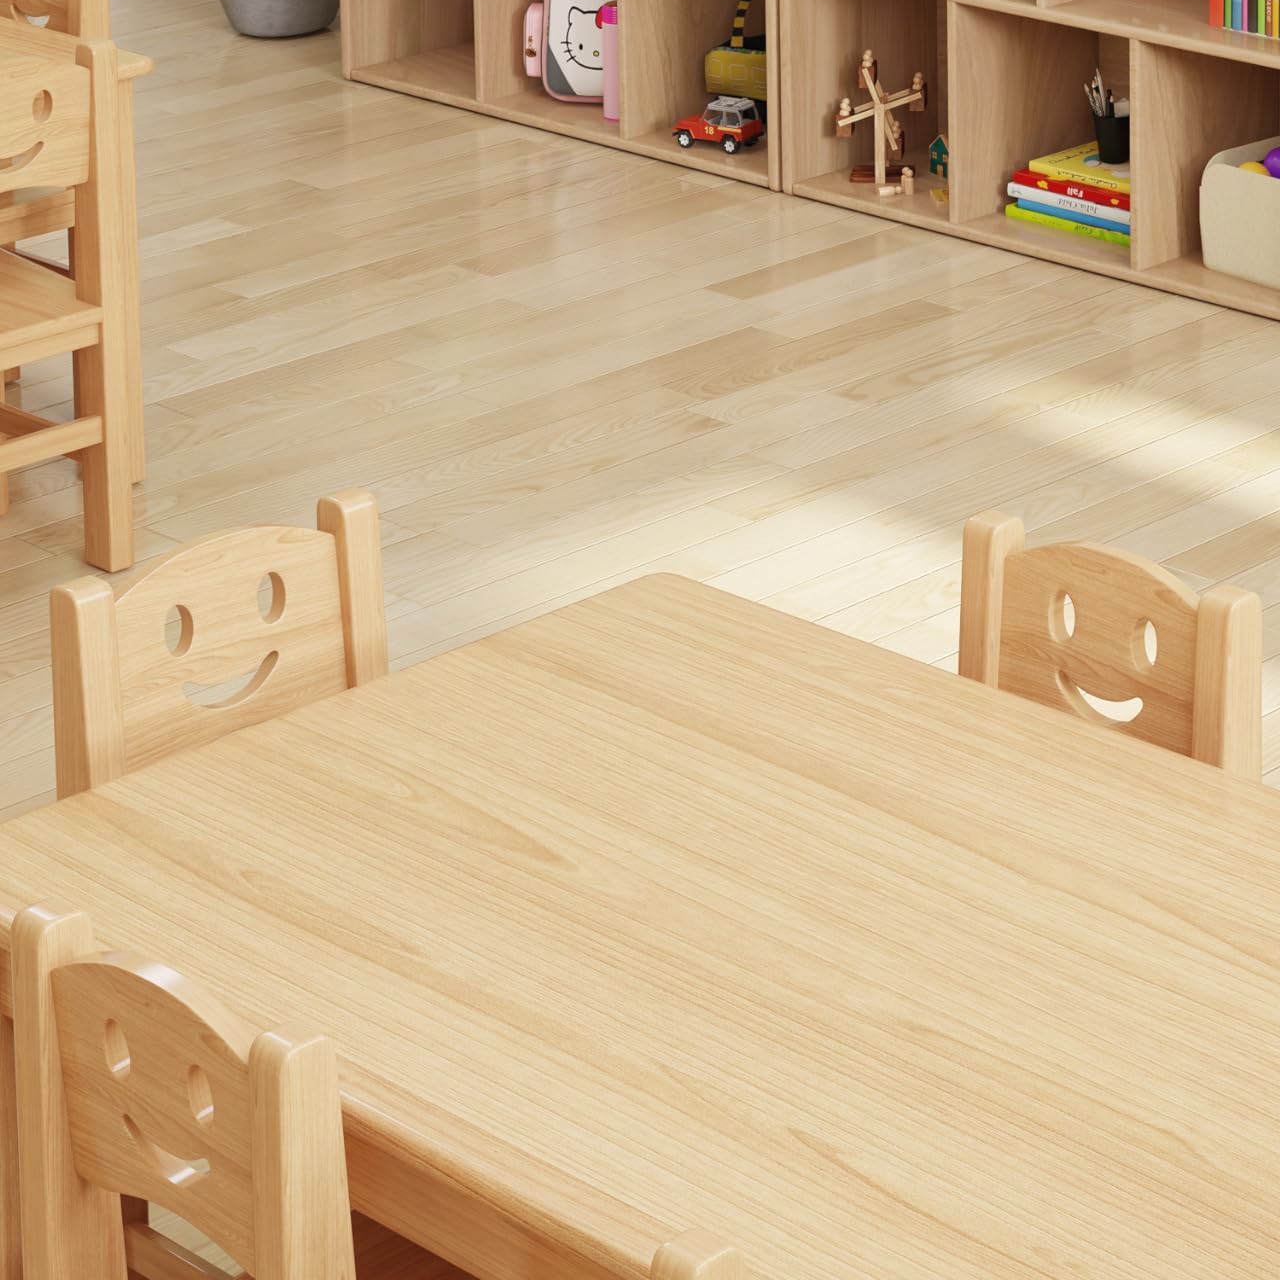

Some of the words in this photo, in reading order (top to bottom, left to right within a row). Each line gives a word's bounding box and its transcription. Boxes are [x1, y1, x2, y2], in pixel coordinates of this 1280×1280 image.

[704, 126, 714, 135] 18
[1066, 187, 1084, 198] Fall
[1057, 198, 1079, 210] Child
